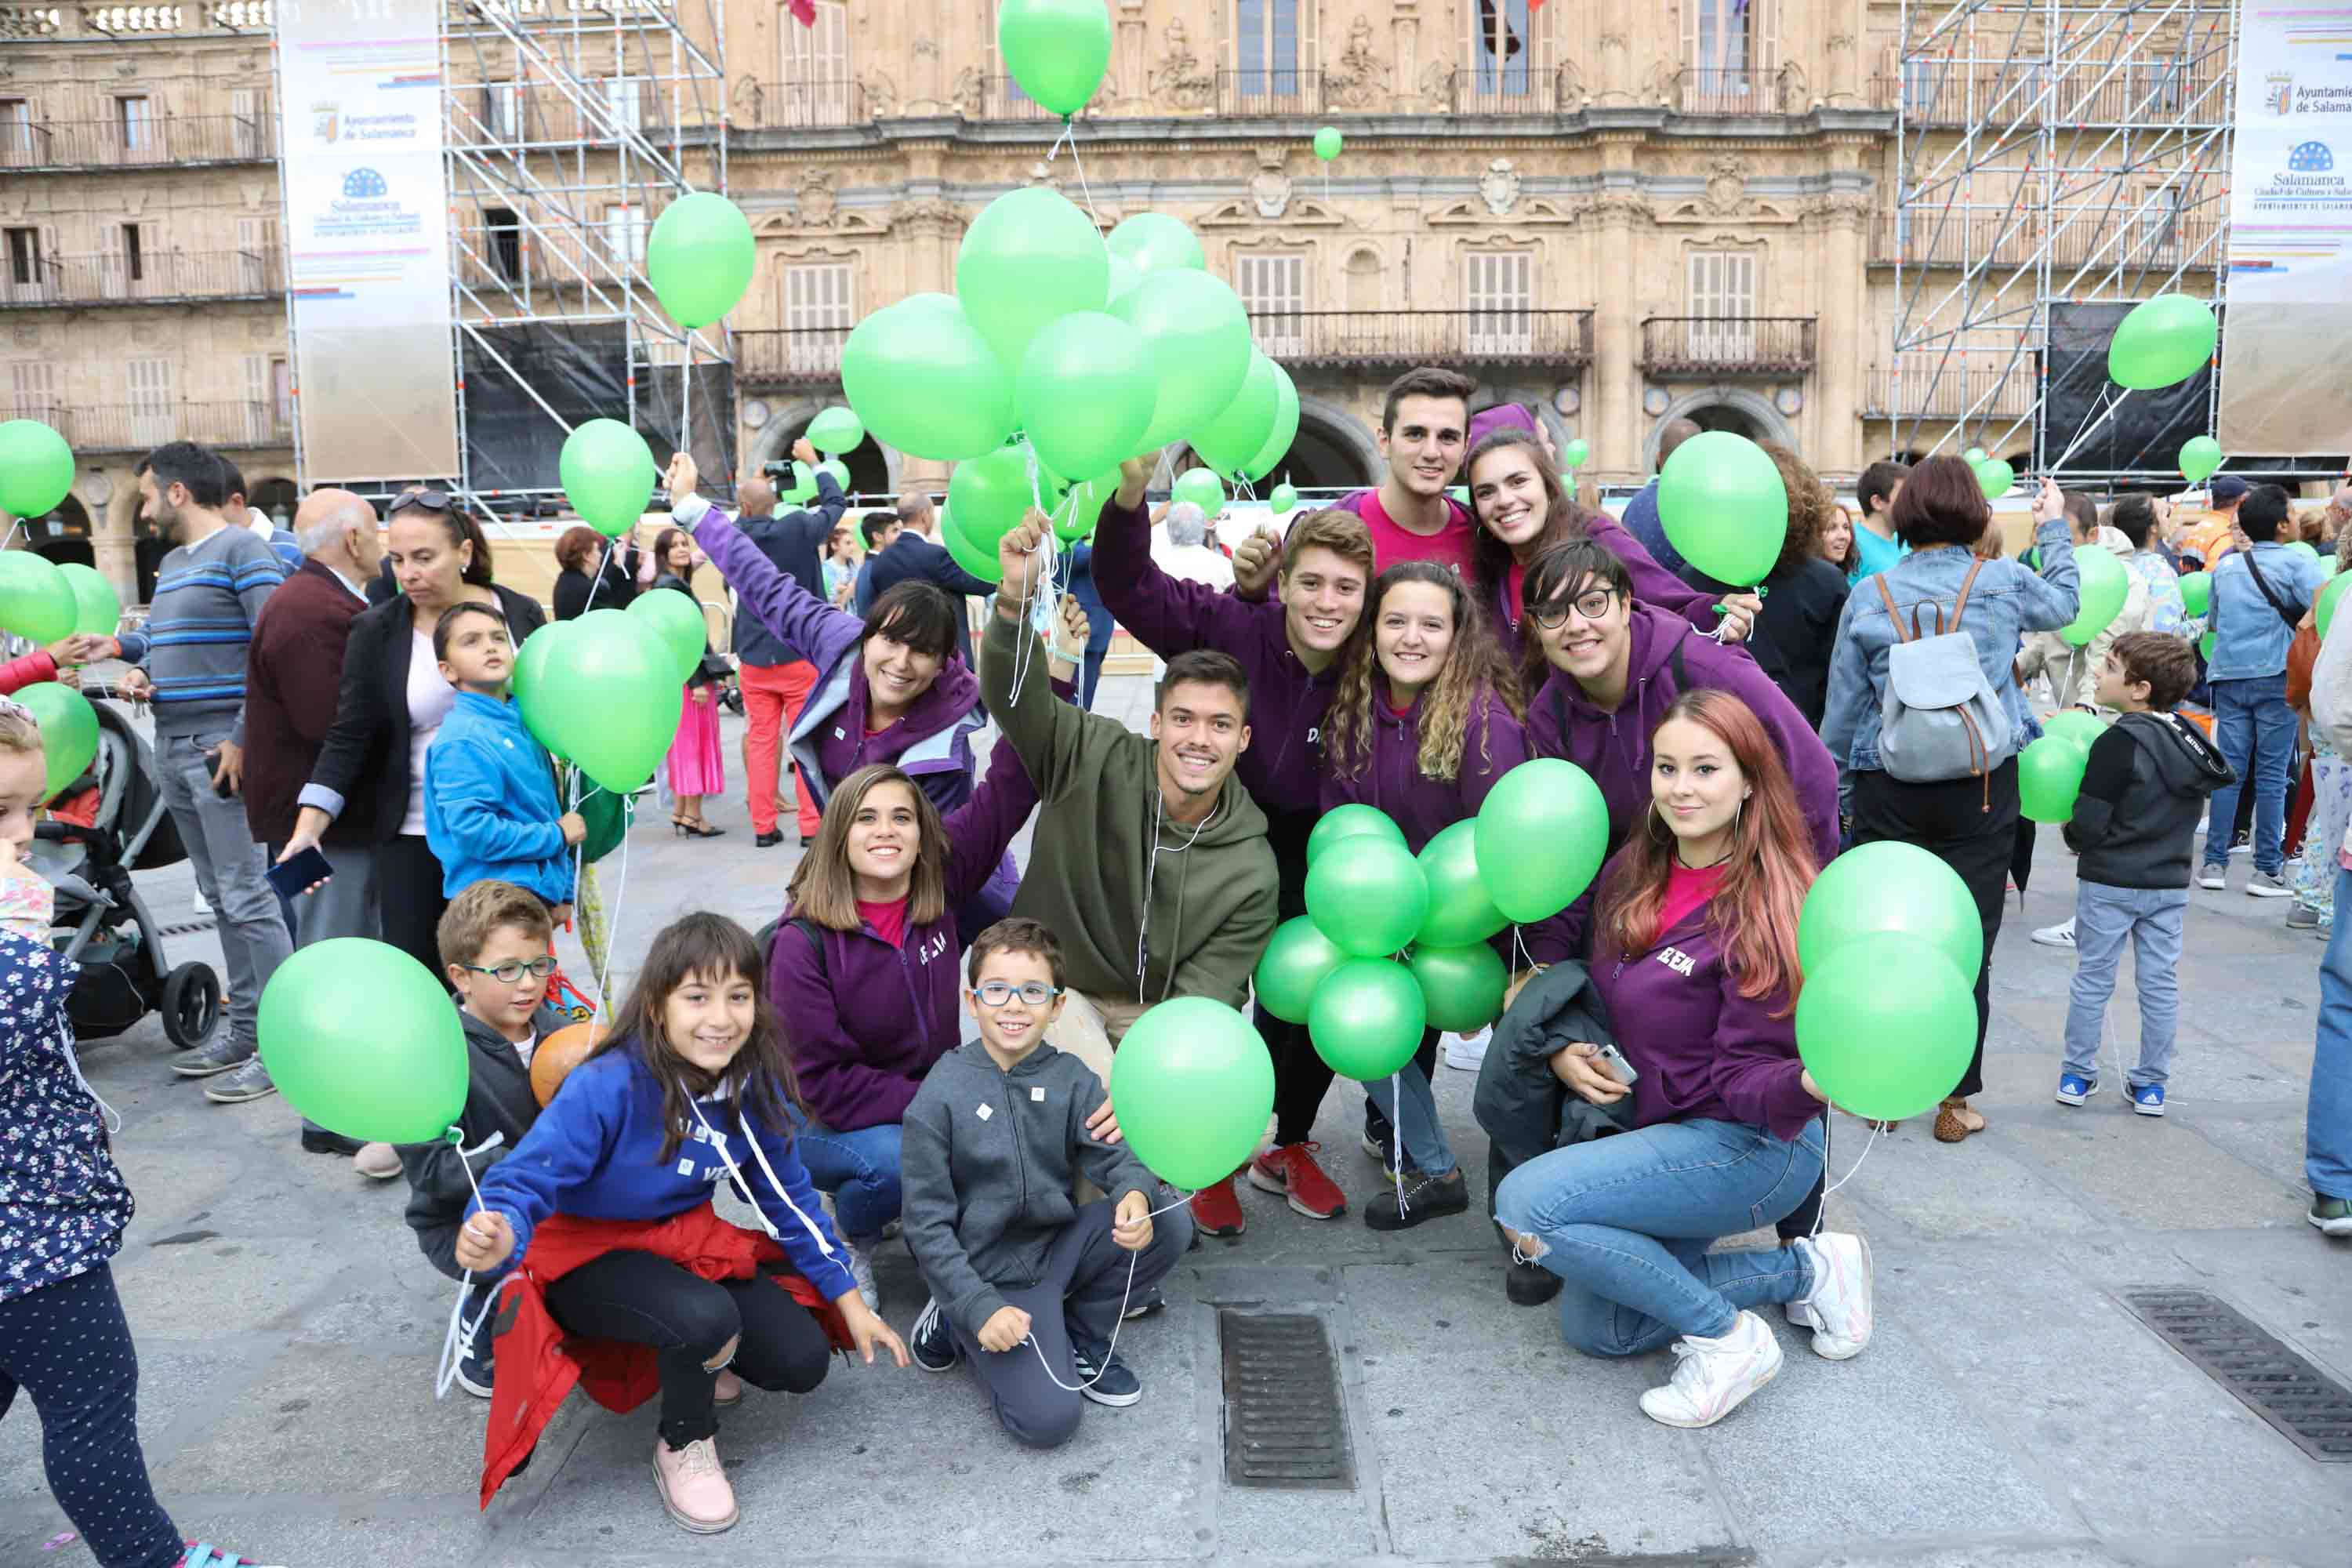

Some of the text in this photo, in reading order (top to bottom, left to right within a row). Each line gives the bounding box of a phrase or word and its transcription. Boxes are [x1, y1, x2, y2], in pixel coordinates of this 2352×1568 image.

[2296, 101, 2352, 113] de Salama
[2273, 172, 2345, 187] Salamanca
